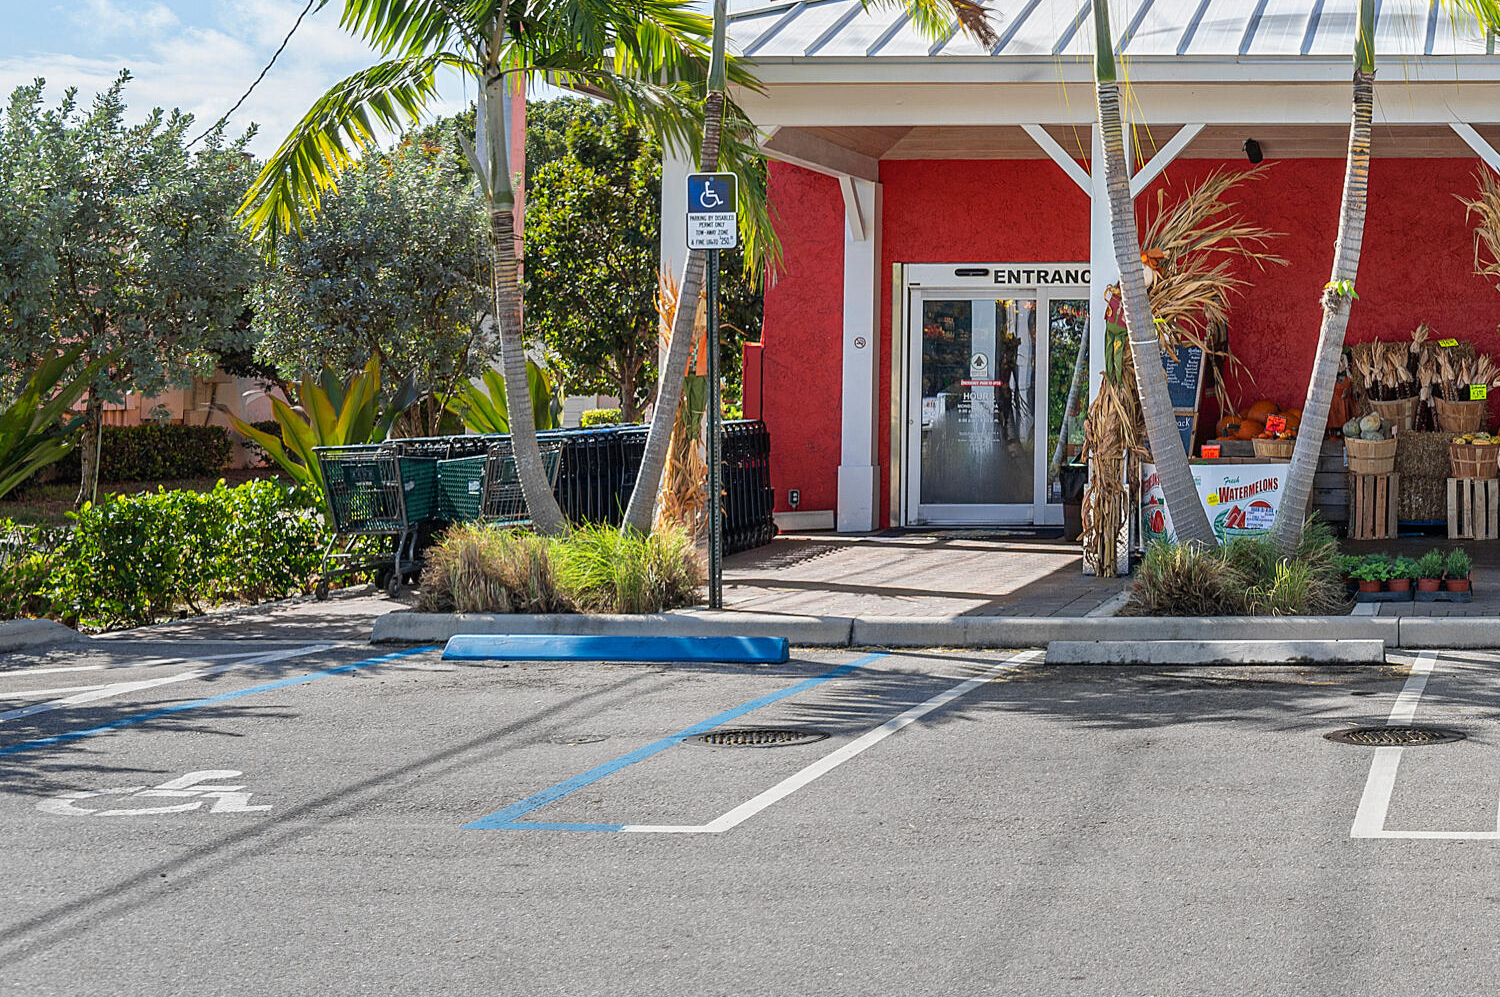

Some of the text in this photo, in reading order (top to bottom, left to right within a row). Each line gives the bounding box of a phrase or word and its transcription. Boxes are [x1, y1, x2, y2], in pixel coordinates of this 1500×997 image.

[994, 269, 1091, 284] ENTRANC
[1223, 475, 1240, 486] Fresh
[1218, 476, 1279, 504] WATERMELONS
